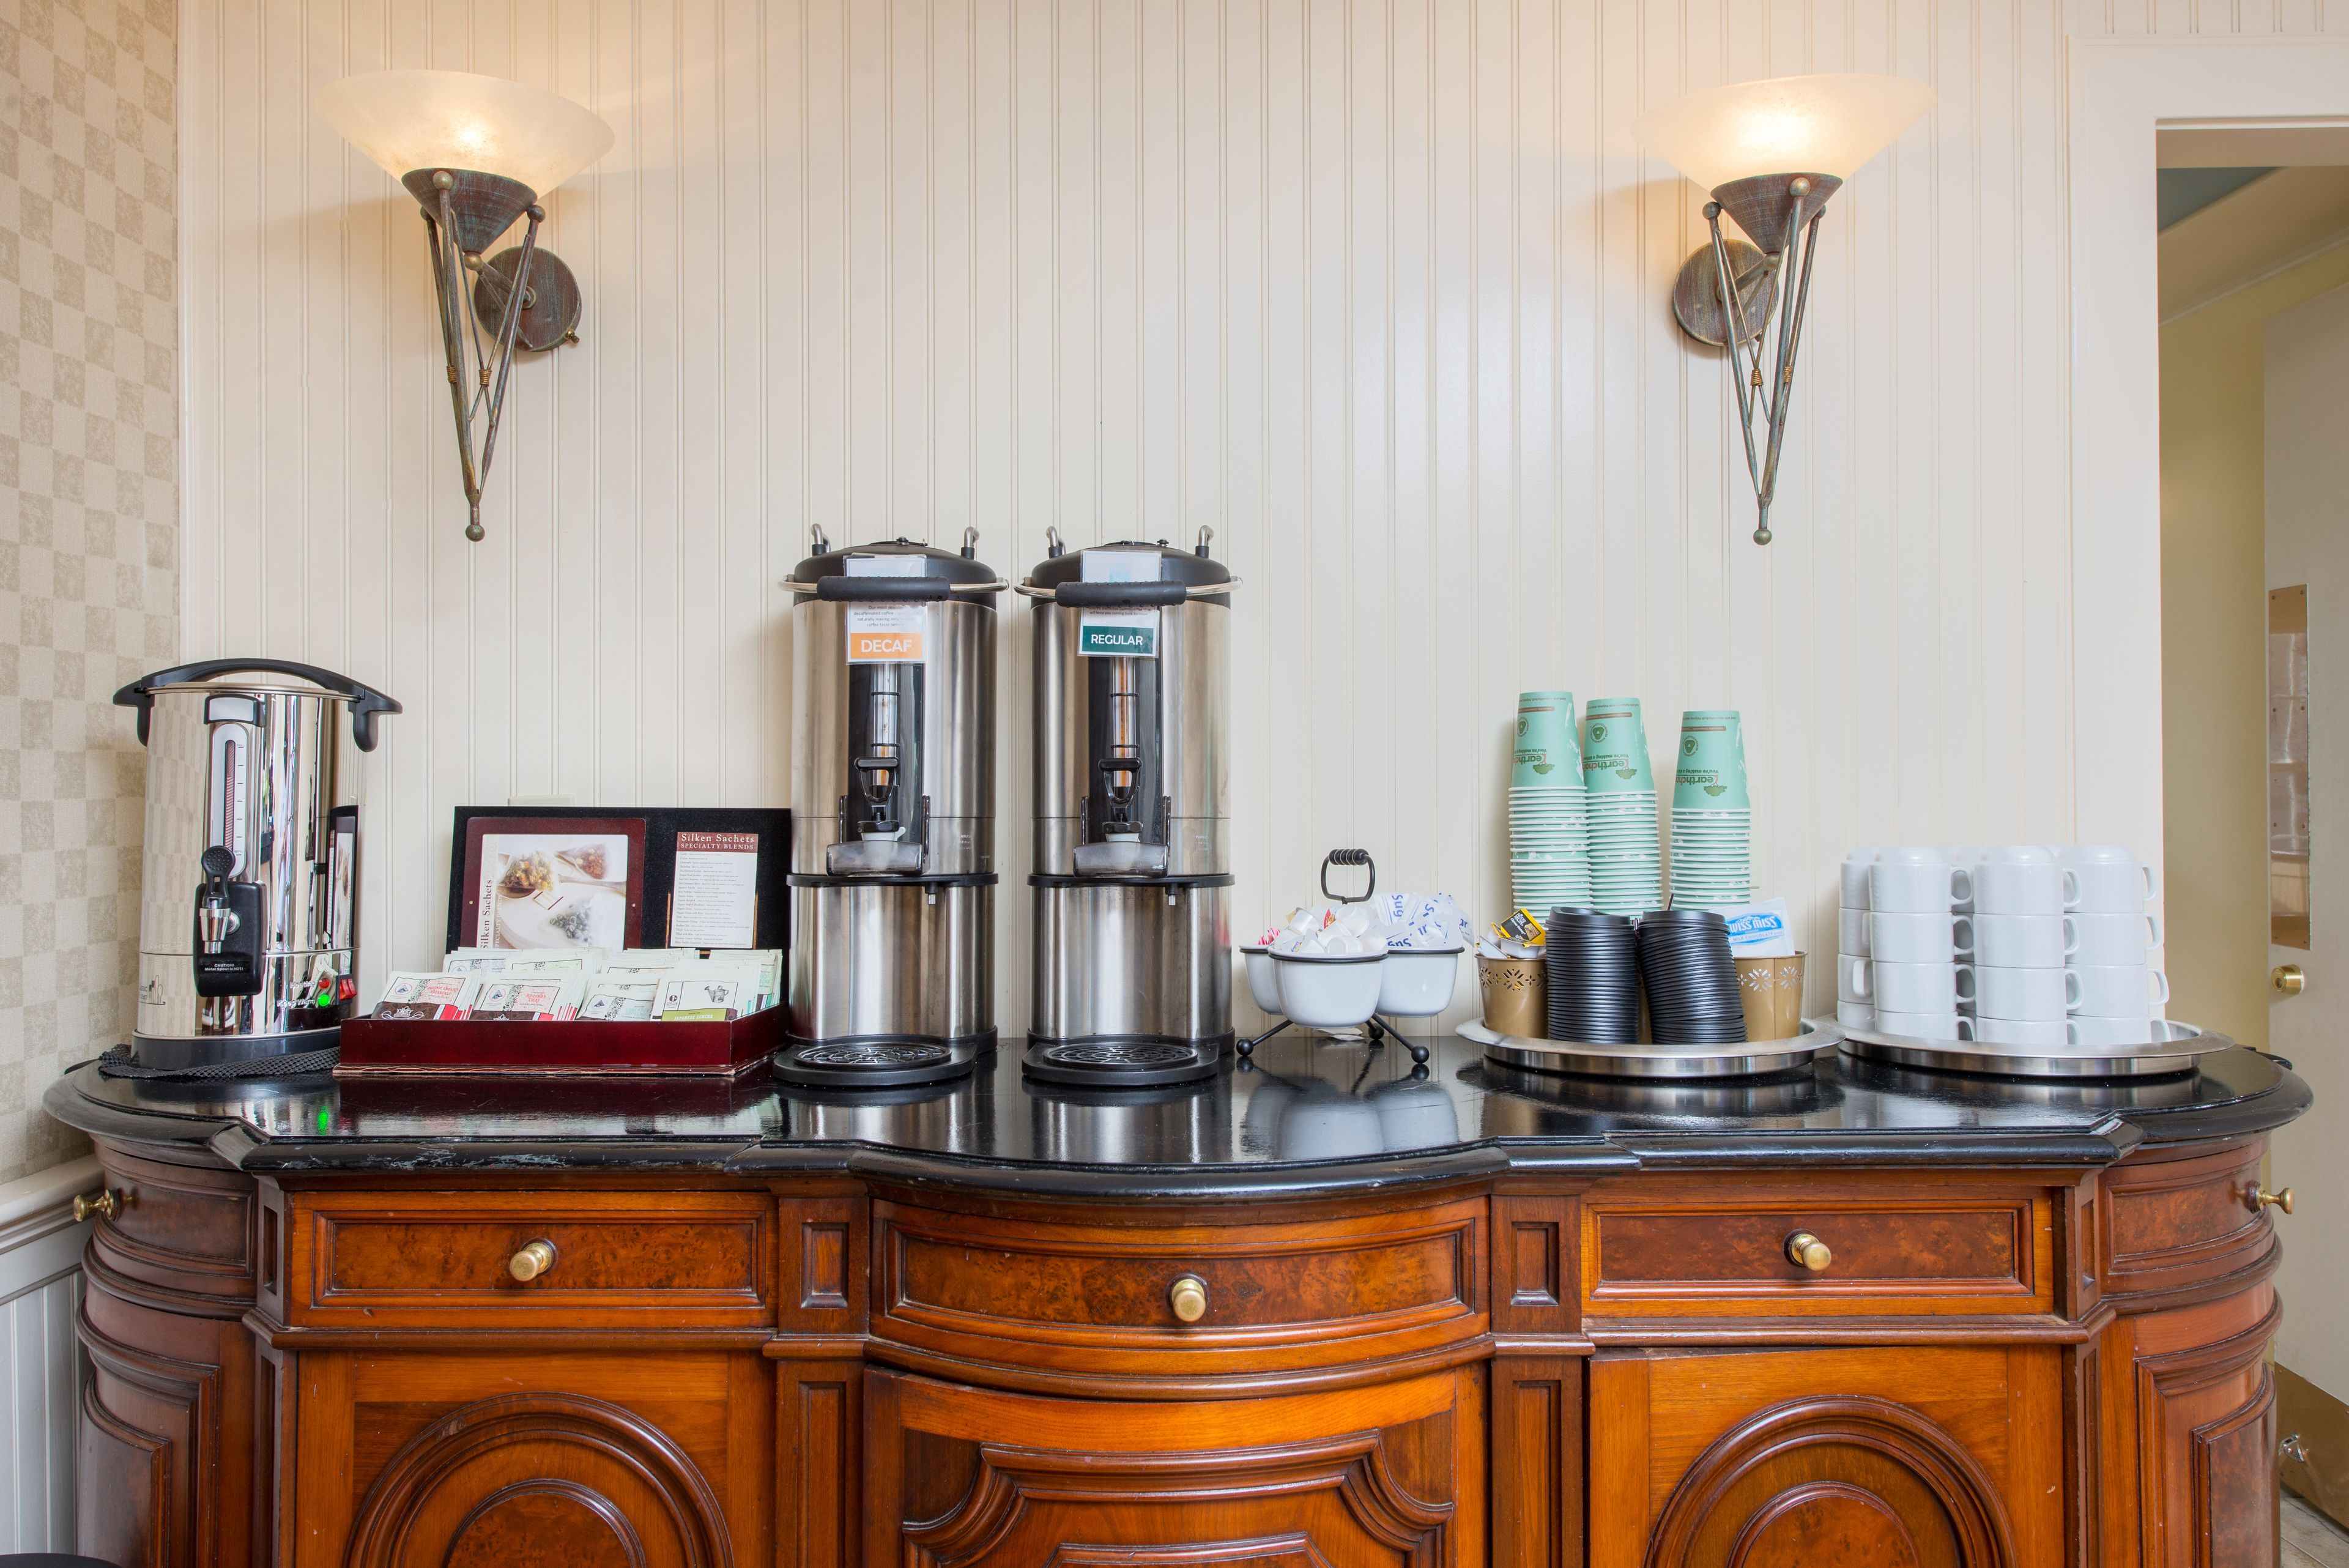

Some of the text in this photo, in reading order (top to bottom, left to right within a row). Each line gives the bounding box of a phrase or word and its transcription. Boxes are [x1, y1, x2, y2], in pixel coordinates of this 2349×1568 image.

[861, 639, 912, 652] DECAF
[1091, 634, 1143, 645] REGULAR
[716, 834, 754, 842] Sachets
[480, 880, 492, 948] Silken Sachets
[1727, 920, 1753, 933] WISS
